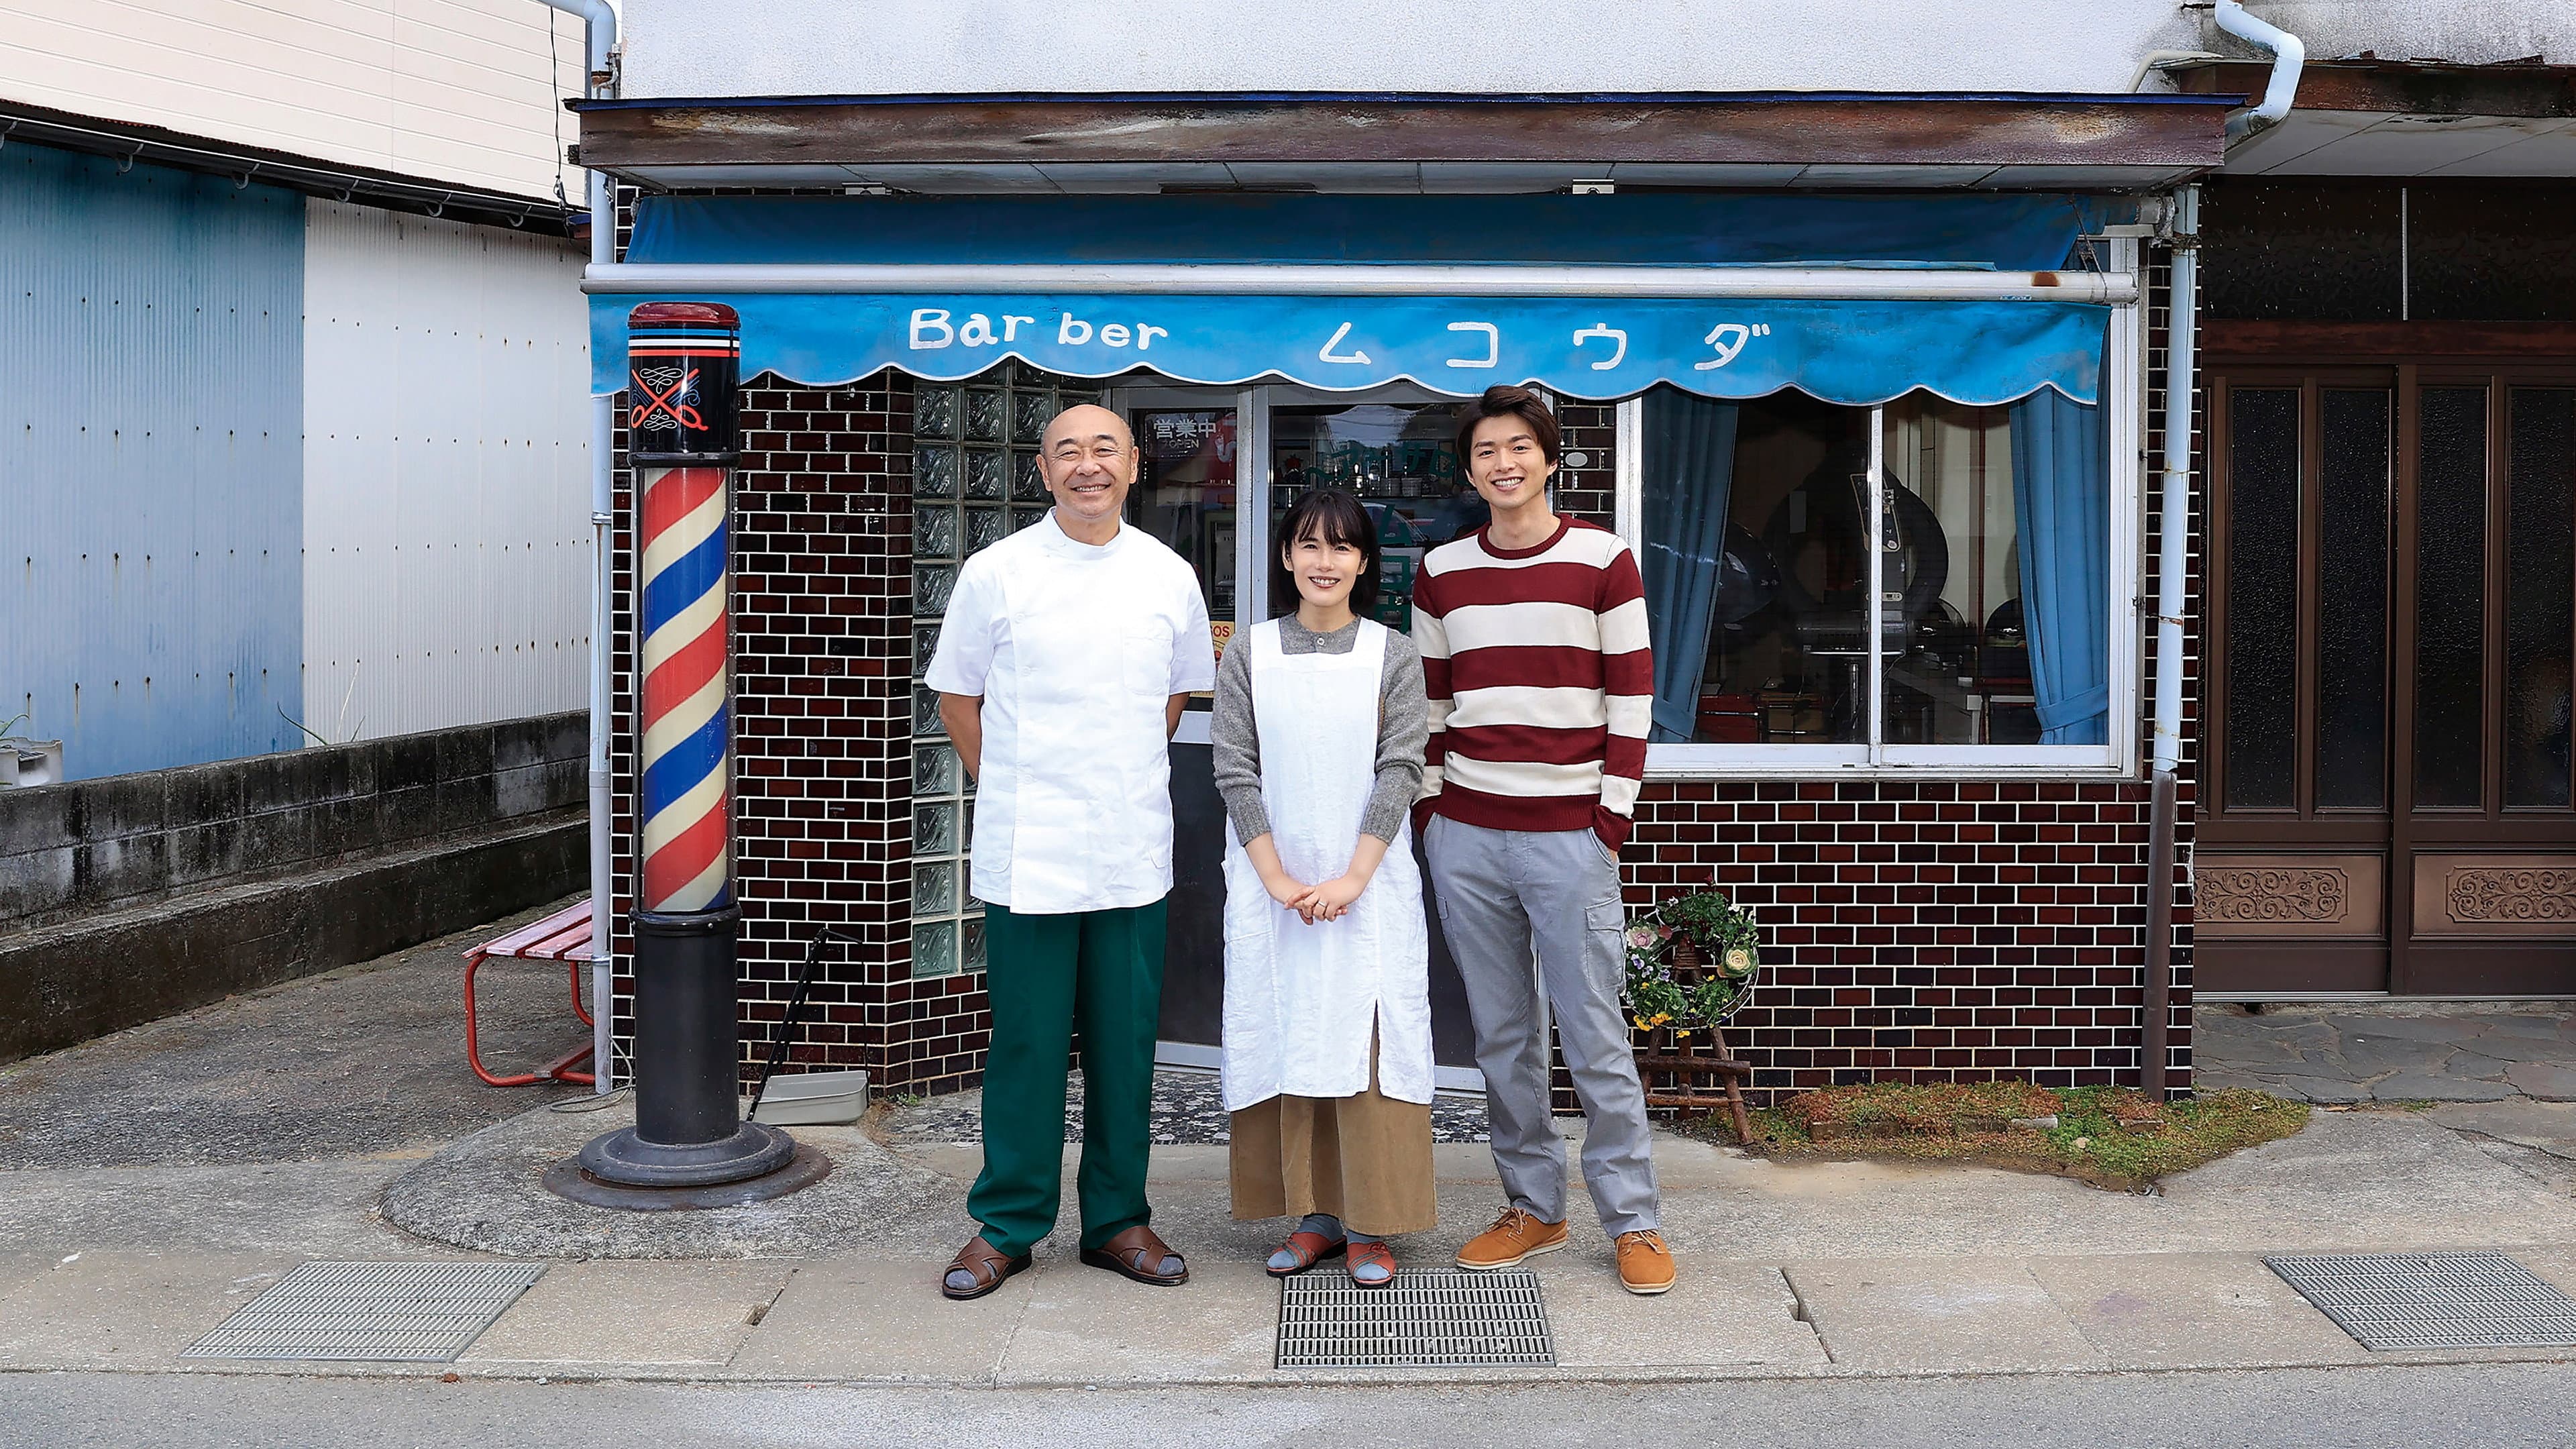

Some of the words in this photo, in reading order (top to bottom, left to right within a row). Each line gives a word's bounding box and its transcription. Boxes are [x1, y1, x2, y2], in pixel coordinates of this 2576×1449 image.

[1319, 321, 1770, 370] ムコウダ
[1153, 418, 1216, 439] 営業中
[1169, 439, 1199, 449] OPEN
[1210, 625, 1230, 637] OS
